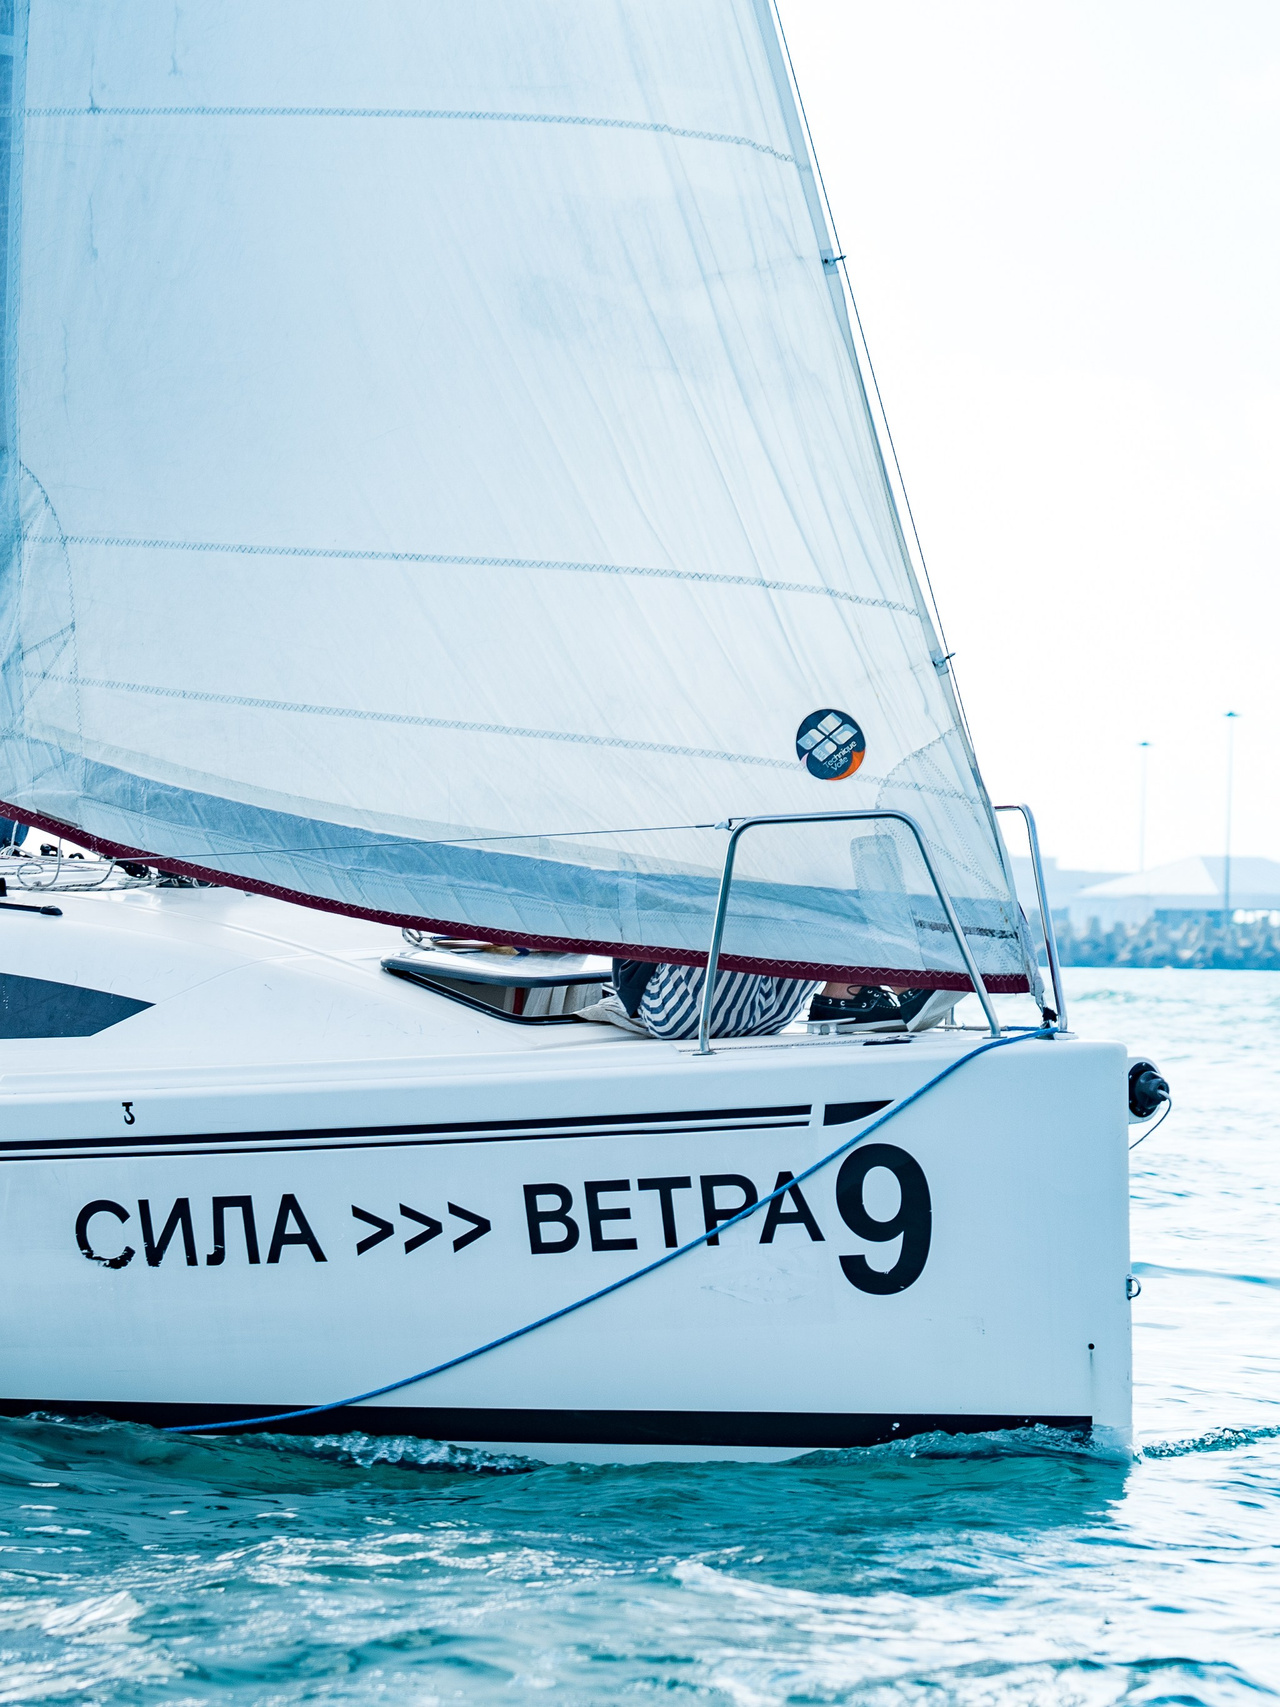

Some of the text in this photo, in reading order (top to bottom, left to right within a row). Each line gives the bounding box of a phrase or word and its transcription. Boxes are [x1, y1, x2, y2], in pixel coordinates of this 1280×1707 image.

[823, 740, 857, 768] Technique
[75, 1194, 327, 1269] СИЛА
[523, 1171, 825, 1255] ВЕТРА
[835, 1143, 932, 1296] 9
